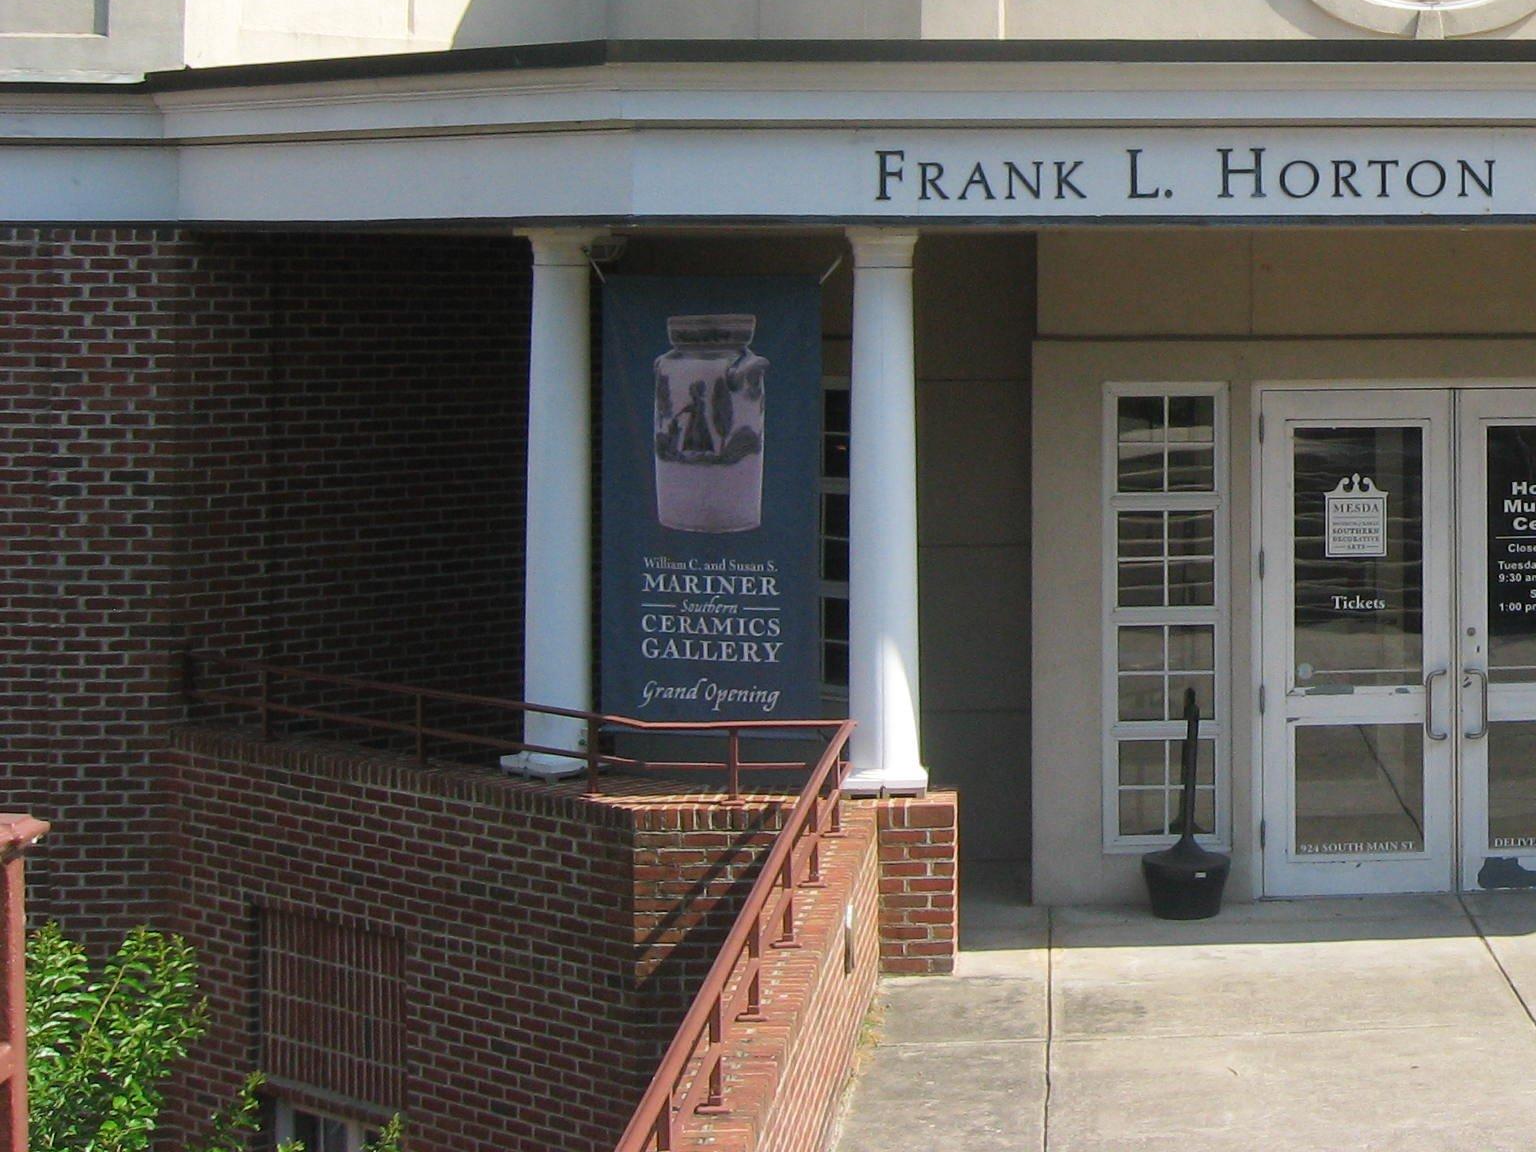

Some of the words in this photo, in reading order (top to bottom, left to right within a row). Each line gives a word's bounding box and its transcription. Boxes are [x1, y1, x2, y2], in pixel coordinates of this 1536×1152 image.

[874, 149, 1088, 201] FRANK
[1126, 148, 1174, 199] L.
[1216, 147, 1496, 199] HORTON
[1333, 503, 1380, 514] MESDA
[643, 556, 687, 570] William
[688, 558, 702, 570] C.
[704, 559, 727, 571] and
[728, 559, 765, 572] Susan
[766, 560, 779, 573] S.
[641, 573, 781, 596] MARINER
[1498, 572, 1523, 583] 9:30
[680, 595, 739, 615] Southern
[1331, 595, 1386, 611] Tickets
[1498, 602, 1523, 612] 1:00
[641, 614, 781, 637] CERAMICS
[641, 638, 784, 663] GALLERY
[637, 678, 708, 708] Grand
[704, 683, 780, 712] Opening
[1301, 844, 1319, 853] 924
[1322, 843, 1363, 852] SOUTH
[1365, 842, 1398, 851] MAIN
